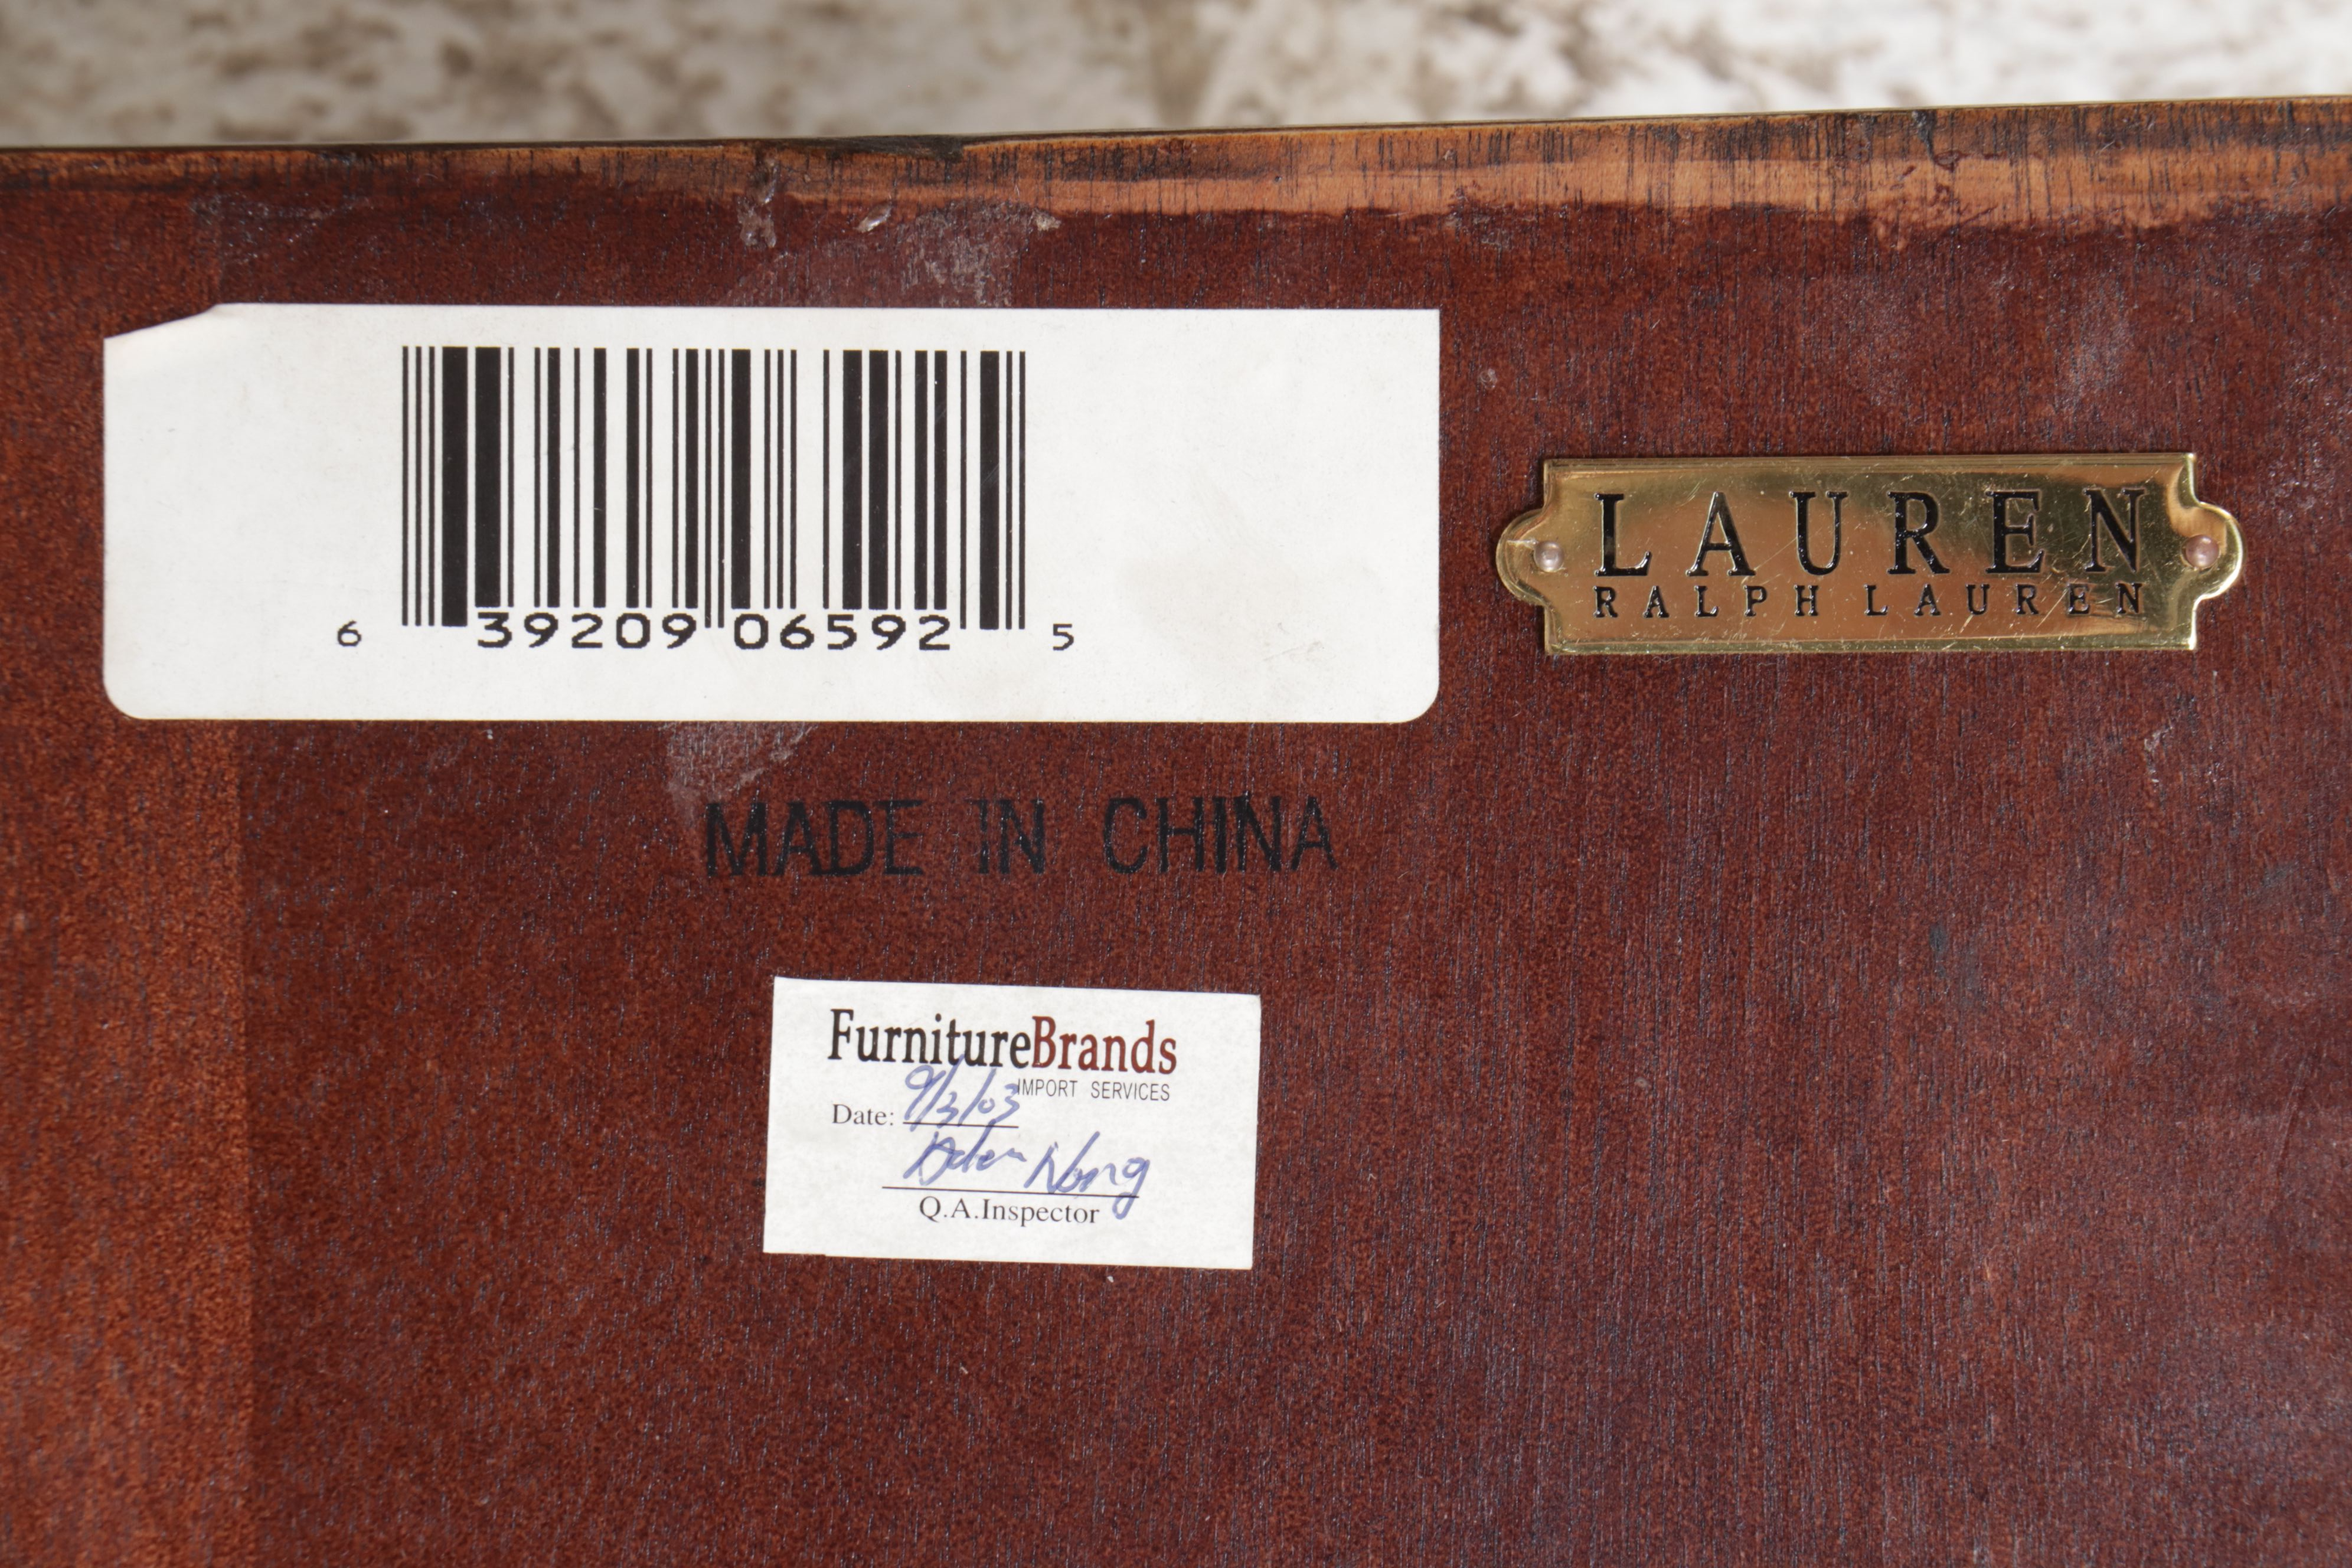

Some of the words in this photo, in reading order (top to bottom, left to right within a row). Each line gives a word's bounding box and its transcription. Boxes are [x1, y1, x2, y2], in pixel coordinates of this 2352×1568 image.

[1594, 488, 2144, 576] LAUREN
[1593, 585, 1819, 619] RALPH
[1864, 582, 2143, 617] LAUREN
[337, 620, 362, 648] 6
[476, 612, 697, 649] 39209
[732, 612, 951, 650] 06592
[1053, 623, 1075, 650] 5
[707, 799, 924, 877] MADE
[977, 799, 1045, 875] IN
[1103, 793, 1338, 874] CHINA
[827, 1008, 1177, 1075] FurnitureBrands
[1017, 1079, 1078, 1099] IMPORT
[1091, 1082, 1171, 1102] SERVICES
[832, 1104, 895, 1126] Date:
[919, 1195, 1100, 1227] Q.A.Inspector
